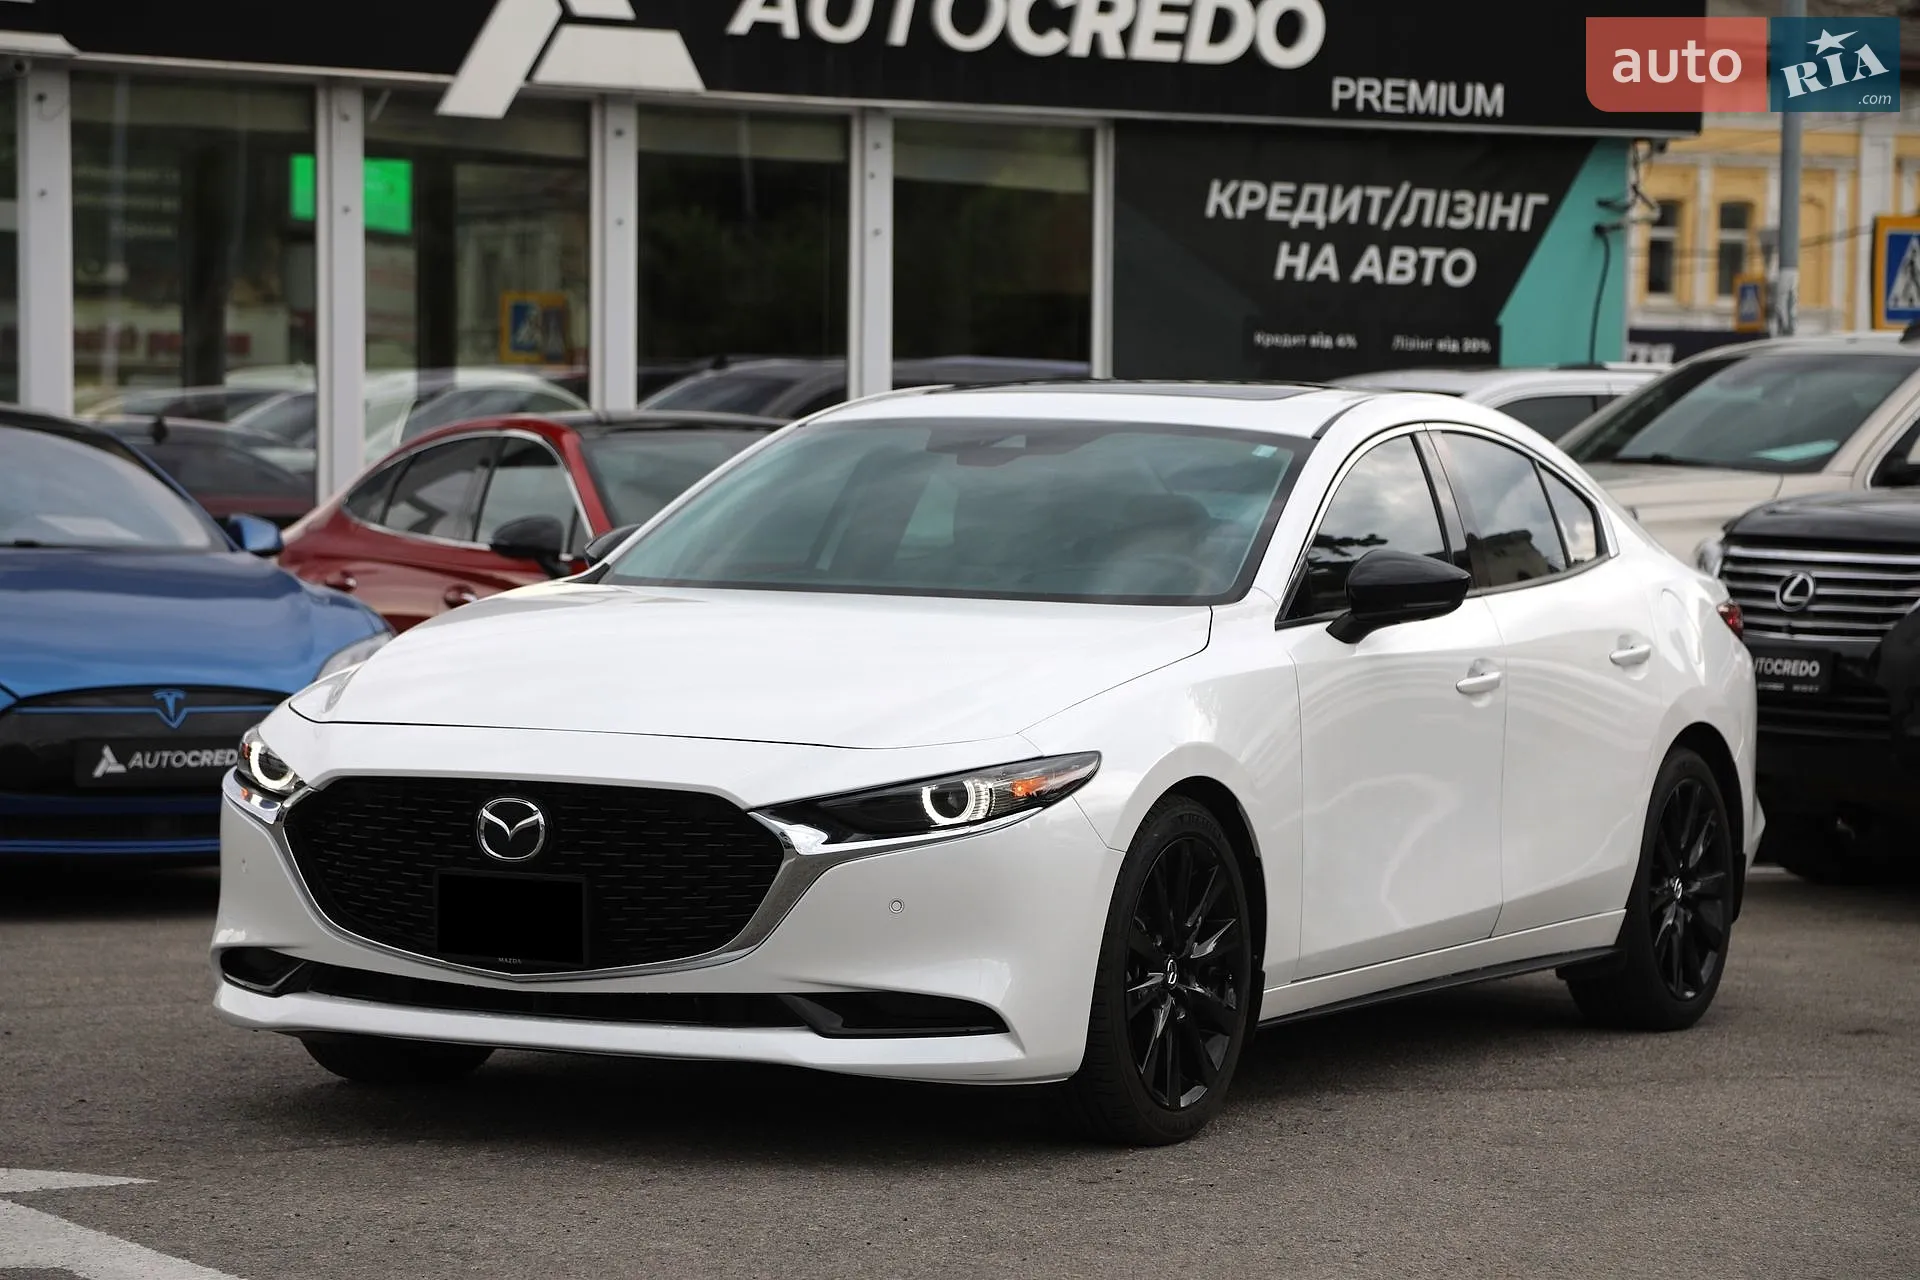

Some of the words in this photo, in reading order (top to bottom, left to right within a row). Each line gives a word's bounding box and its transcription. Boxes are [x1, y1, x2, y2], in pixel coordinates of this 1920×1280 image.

[1332, 76, 1505, 117] PREMIUM
[1205, 179, 1549, 231] КРЕДИТ/ЛІЗІНГ
[1274, 242, 1340, 282] НА
[1350, 245, 1477, 288] АВТО
